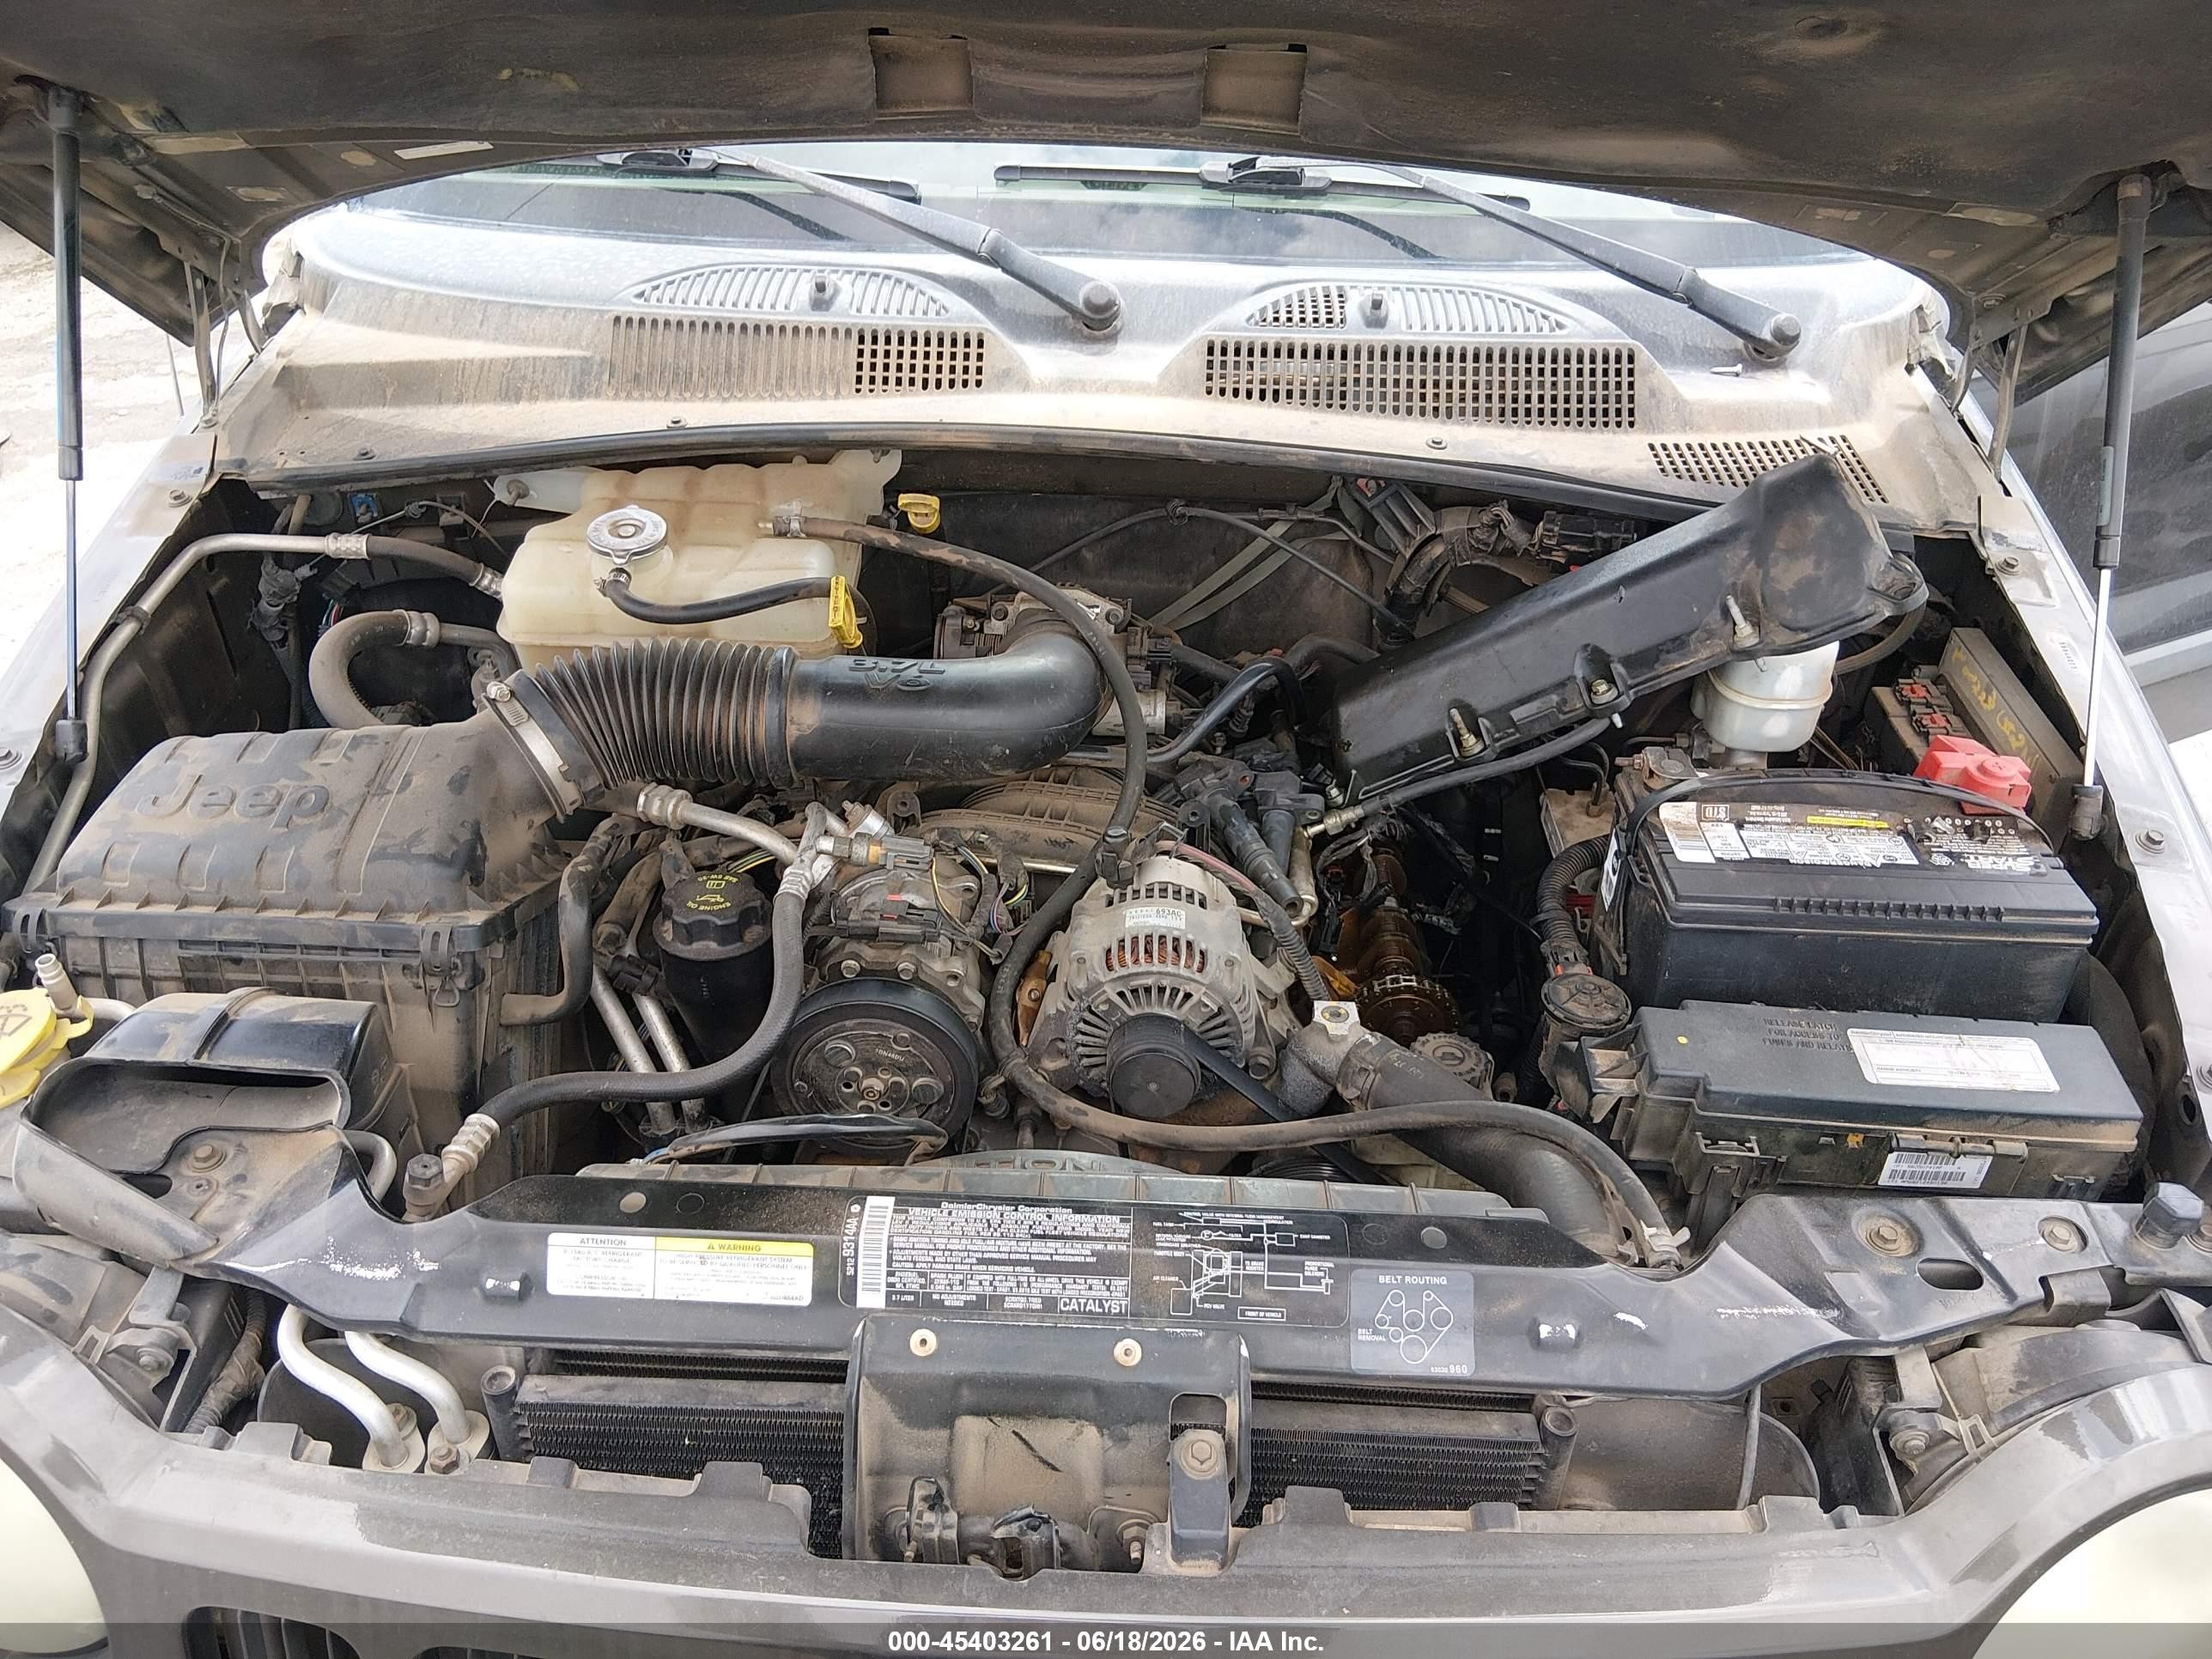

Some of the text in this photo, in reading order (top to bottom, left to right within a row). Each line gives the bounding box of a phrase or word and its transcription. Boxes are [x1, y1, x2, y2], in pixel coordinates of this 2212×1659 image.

[848, 659, 945, 674] 3.7L
[864, 672, 930, 690] V6
[136, 774, 331, 831] Jeep
[1156, 908, 1182, 917] 693AC
[1766, 1028, 1787, 1036] FOR
[1790, 1030, 1826, 1040] ACCESS
[1762, 1037, 1793, 1047] FUSES
[1796, 1040, 1814, 1048] AND
[941, 1201, 1073, 1214] DaimlerChrysler Corporation
[908, 1208, 1121, 1224] VEHICLE EMISSION CONTROL INFORMATION
[580, 1237, 762, 1251] ATTENTION WARNING
[1378, 1275, 1448, 1285] BELT ROUTING
[1060, 1298, 1128, 1314] CATALYST
